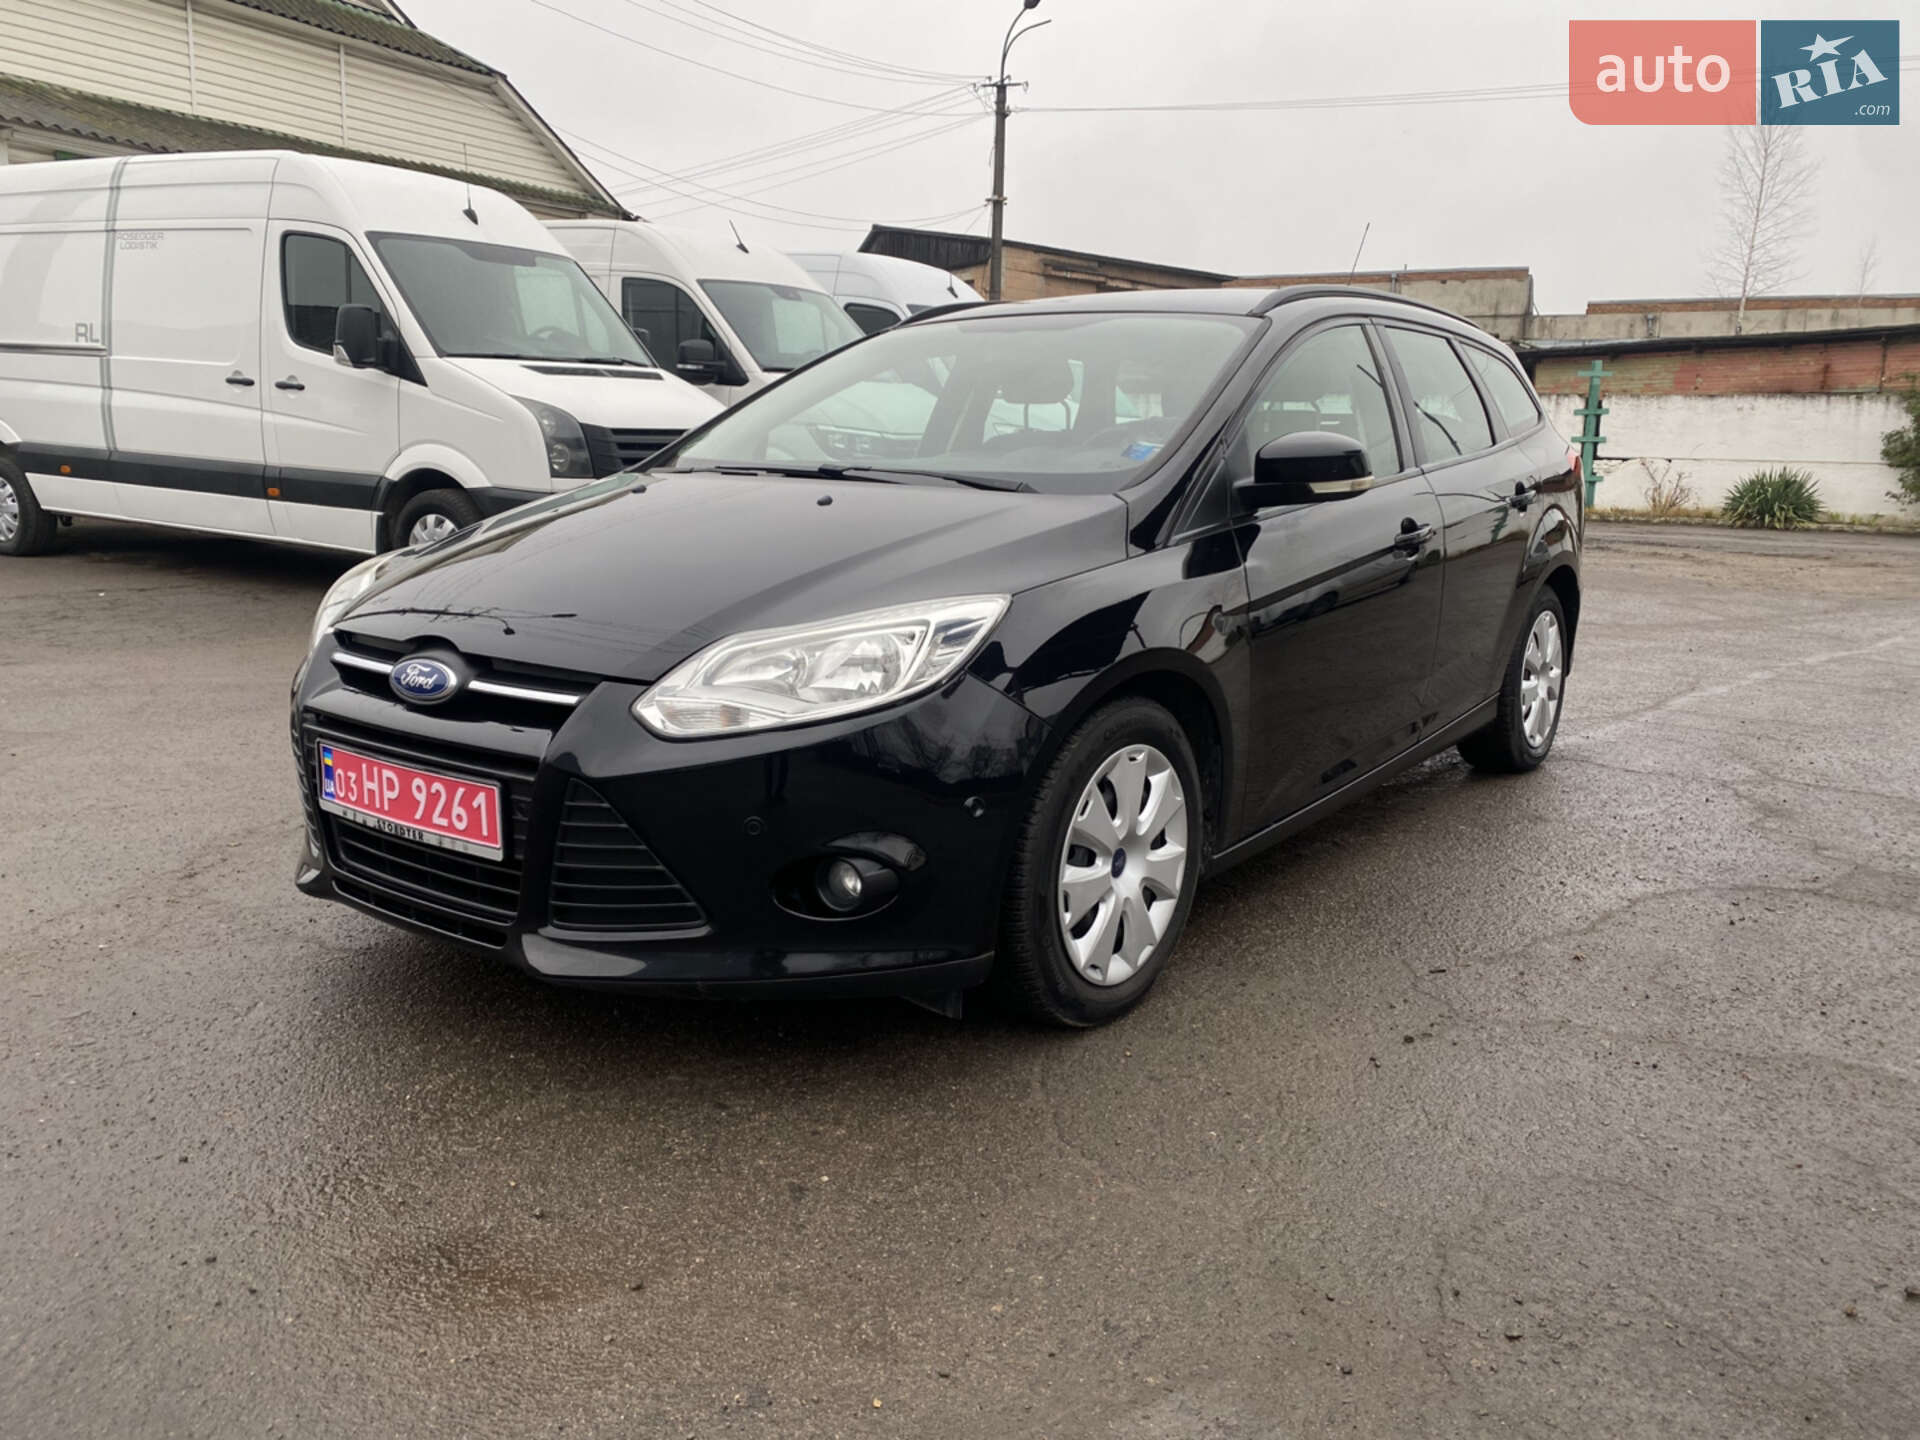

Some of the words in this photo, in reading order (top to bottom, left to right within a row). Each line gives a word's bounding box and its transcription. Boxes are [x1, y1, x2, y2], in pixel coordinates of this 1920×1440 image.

[75, 322, 100, 343] RL
[401, 663, 438, 690] Ford
[411, 777, 489, 836] 9261
